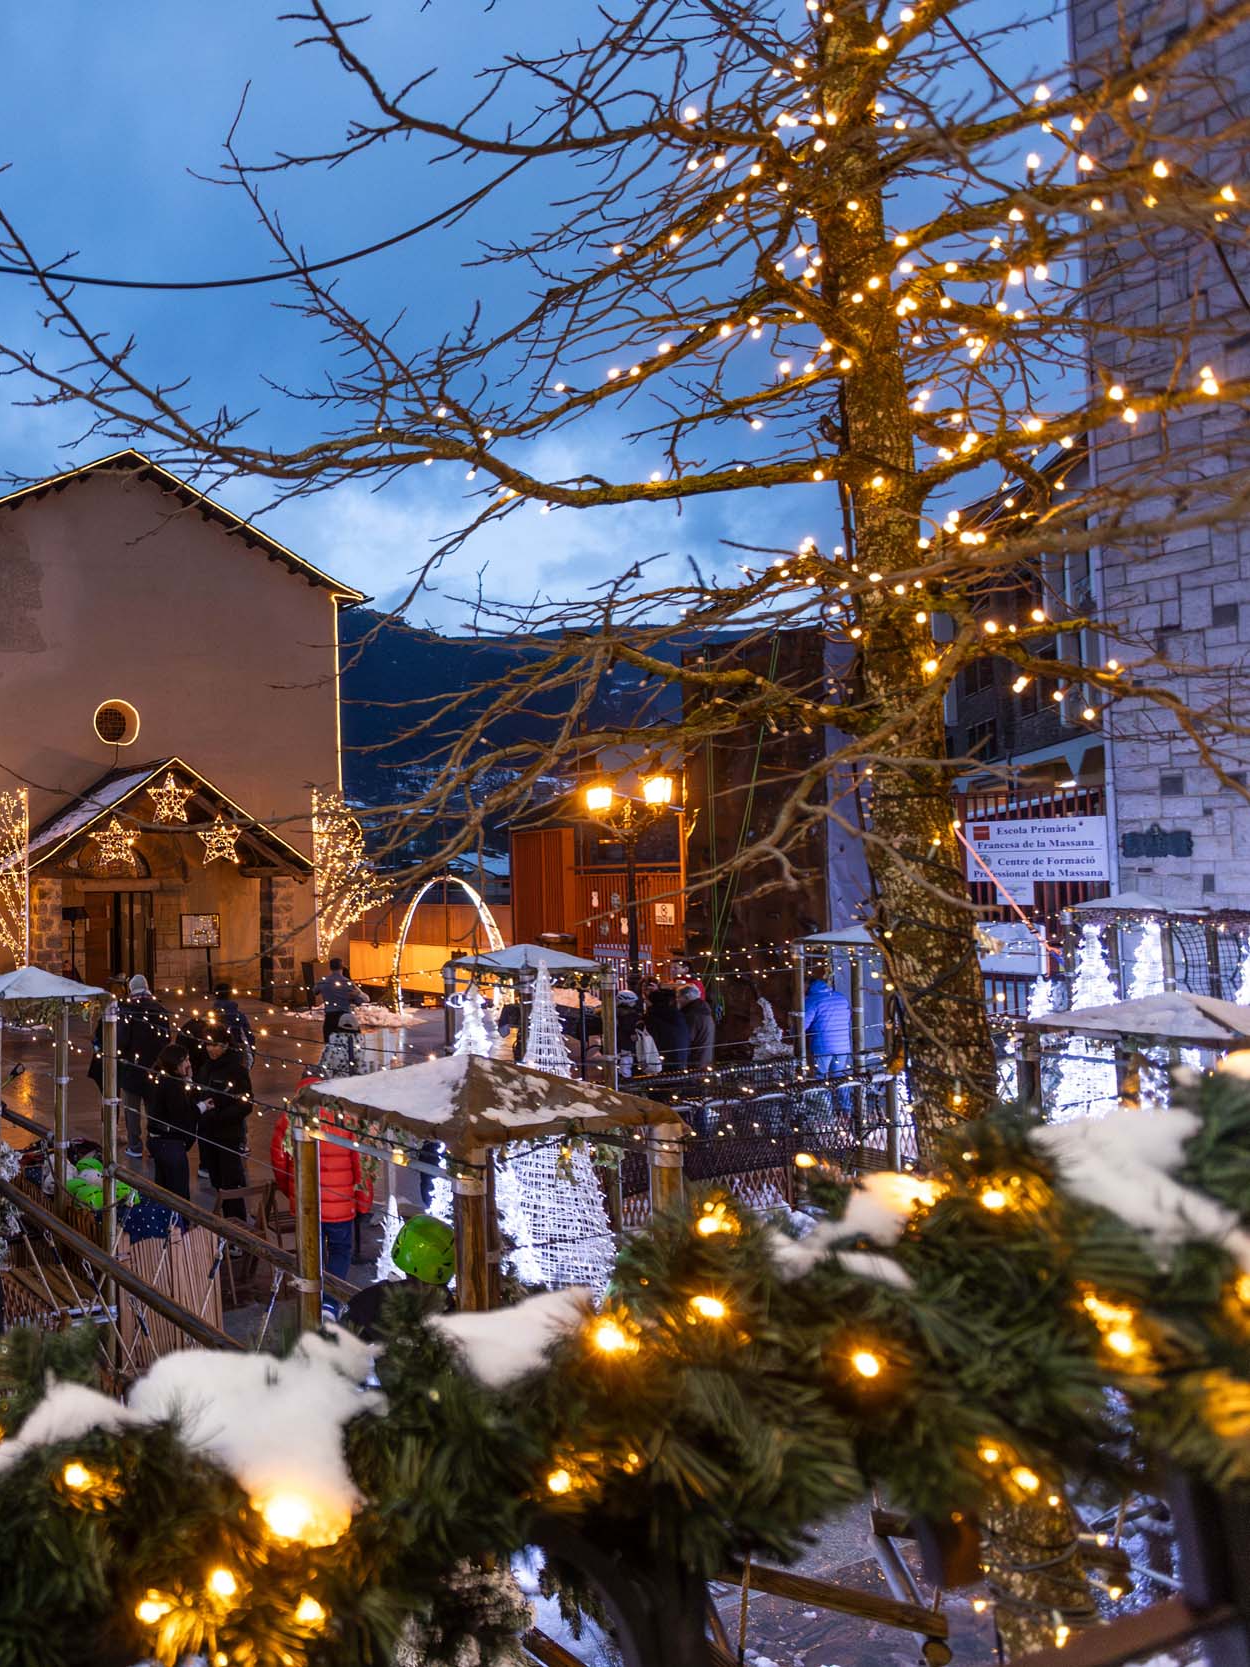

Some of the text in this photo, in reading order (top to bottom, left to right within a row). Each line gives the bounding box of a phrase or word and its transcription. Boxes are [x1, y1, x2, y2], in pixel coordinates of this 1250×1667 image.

[997, 826, 1028, 835] Escola
[1022, 840, 1034, 848] de
[1037, 839, 1046, 848] la
[1049, 839, 1095, 848] Massana
[998, 855, 1096, 866] Centre de Formació
[1032, 869, 1045, 877] de
[1046, 869, 1055, 877] la
[1058, 868, 1103, 877] Massana
